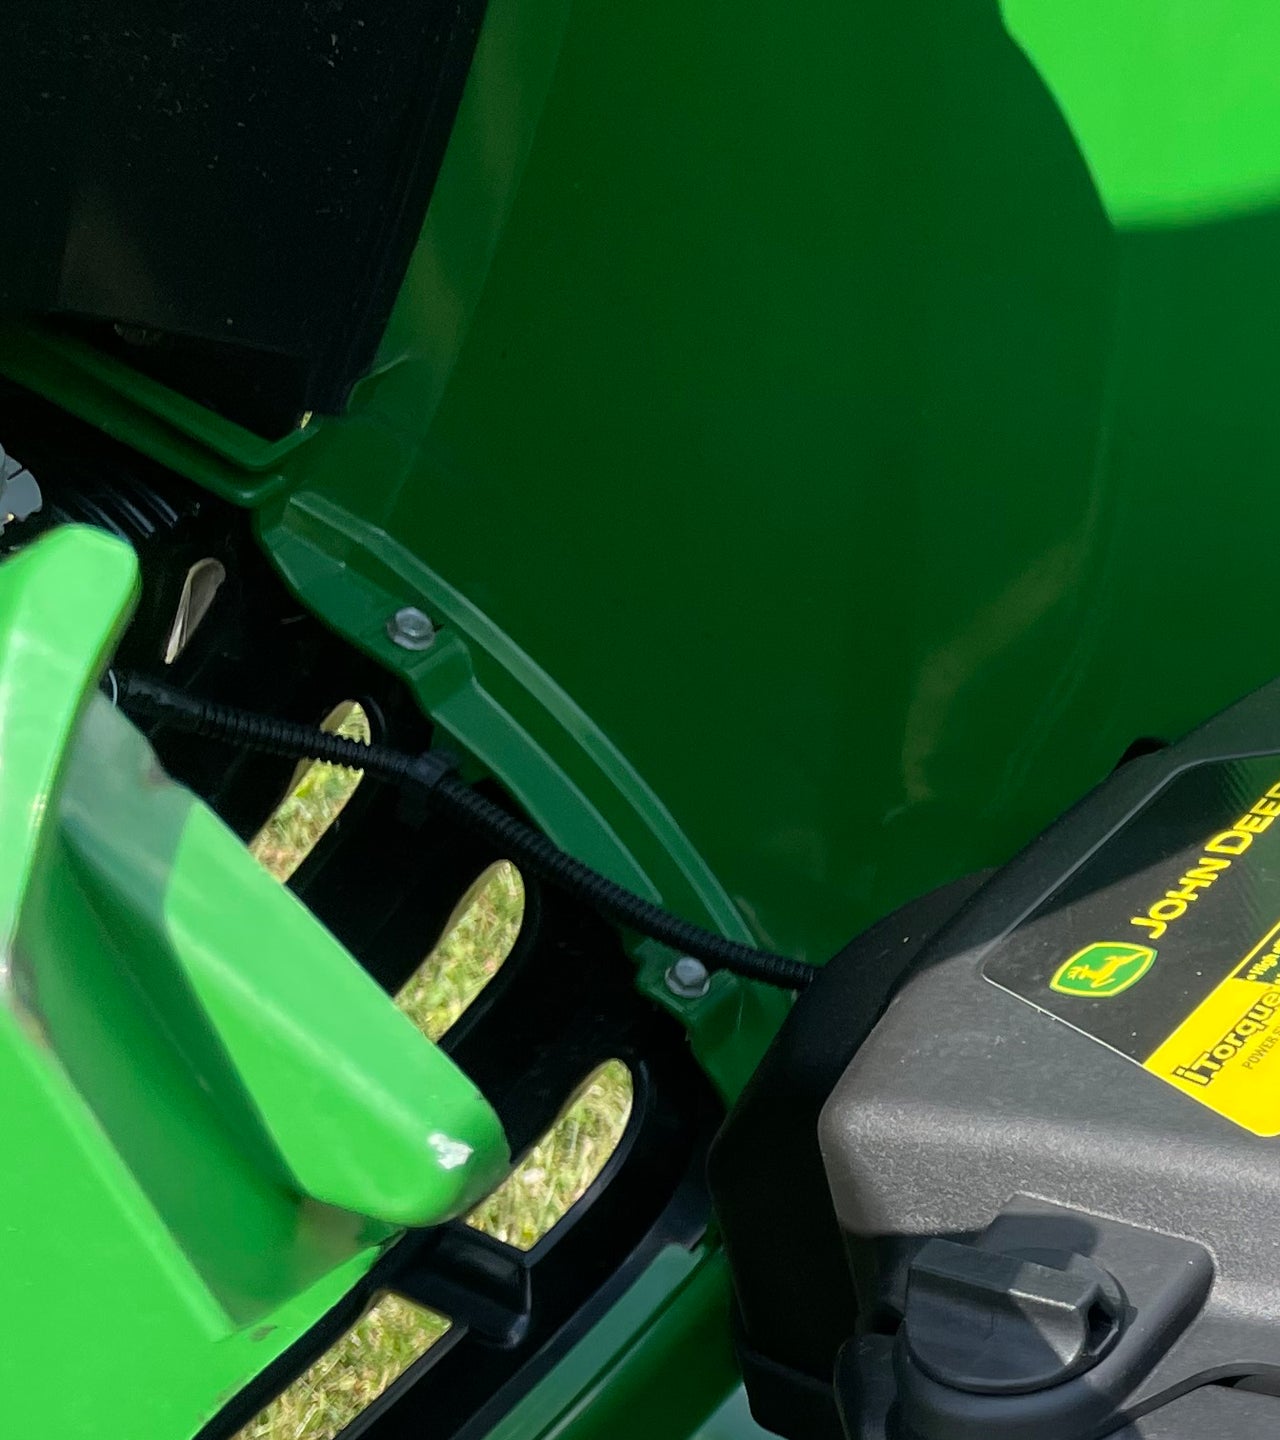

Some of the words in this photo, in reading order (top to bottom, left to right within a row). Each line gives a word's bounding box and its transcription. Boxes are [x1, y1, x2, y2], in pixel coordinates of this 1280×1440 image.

[1131, 857, 1231, 939] JOHN
[1248, 953, 1280, 976] High
[1242, 1036, 1279, 1070] POWER
